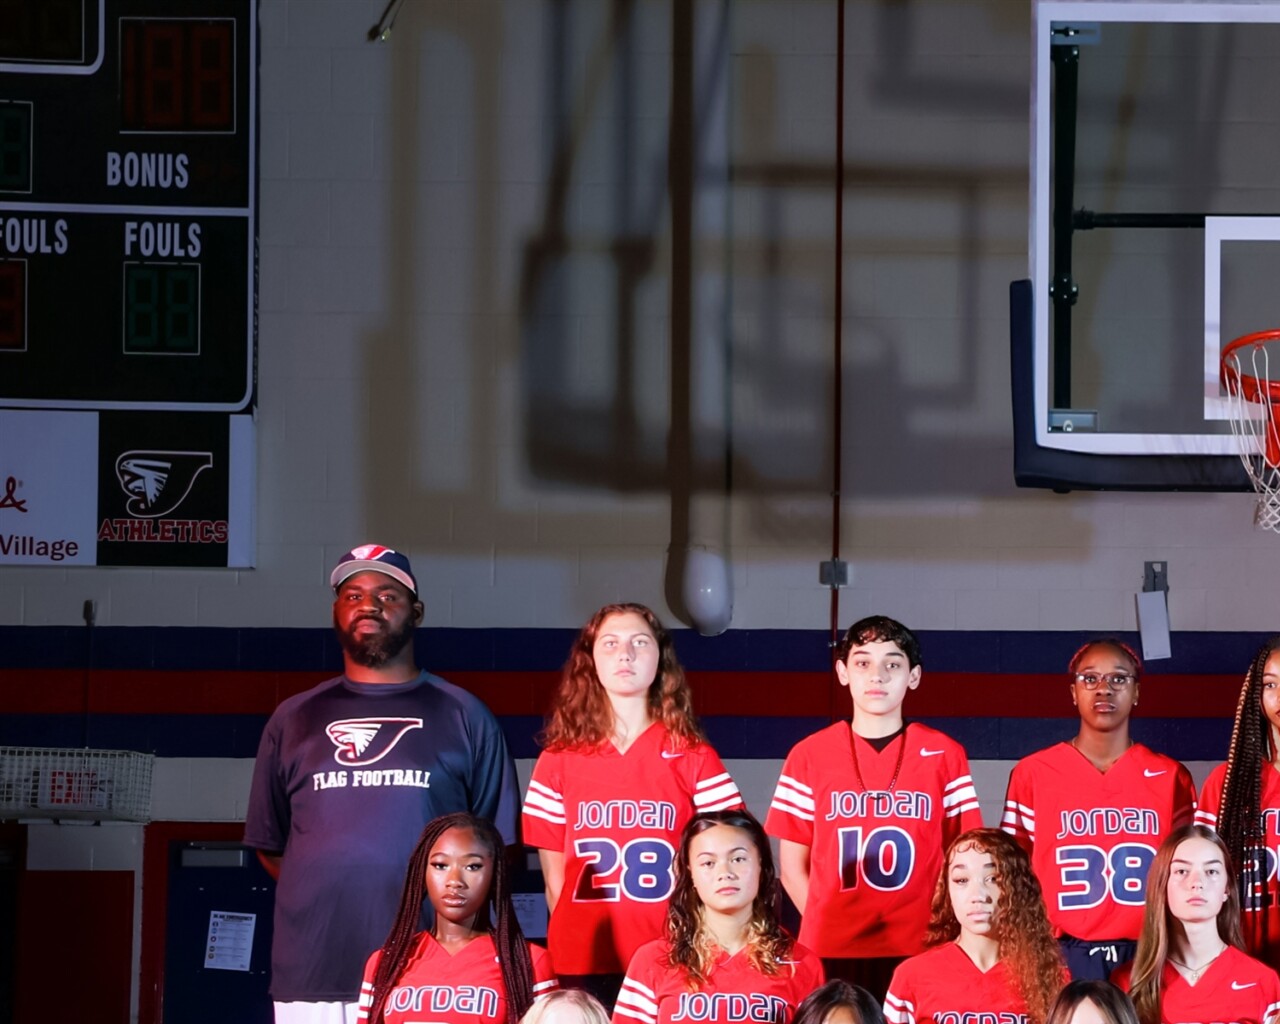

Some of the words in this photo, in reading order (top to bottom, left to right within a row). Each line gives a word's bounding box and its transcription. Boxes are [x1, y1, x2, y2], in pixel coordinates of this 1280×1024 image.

[106, 151, 189, 189] BONUS
[0, 217, 69, 255] OULS
[125, 221, 202, 258] FOULS
[97, 518, 229, 544] ATHLETICS
[313, 770, 348, 791] FLAG
[352, 768, 432, 788] FOOTBALL
[573, 837, 675, 902] 28
[837, 826, 916, 892] 10
[1054, 842, 1158, 911] 38
